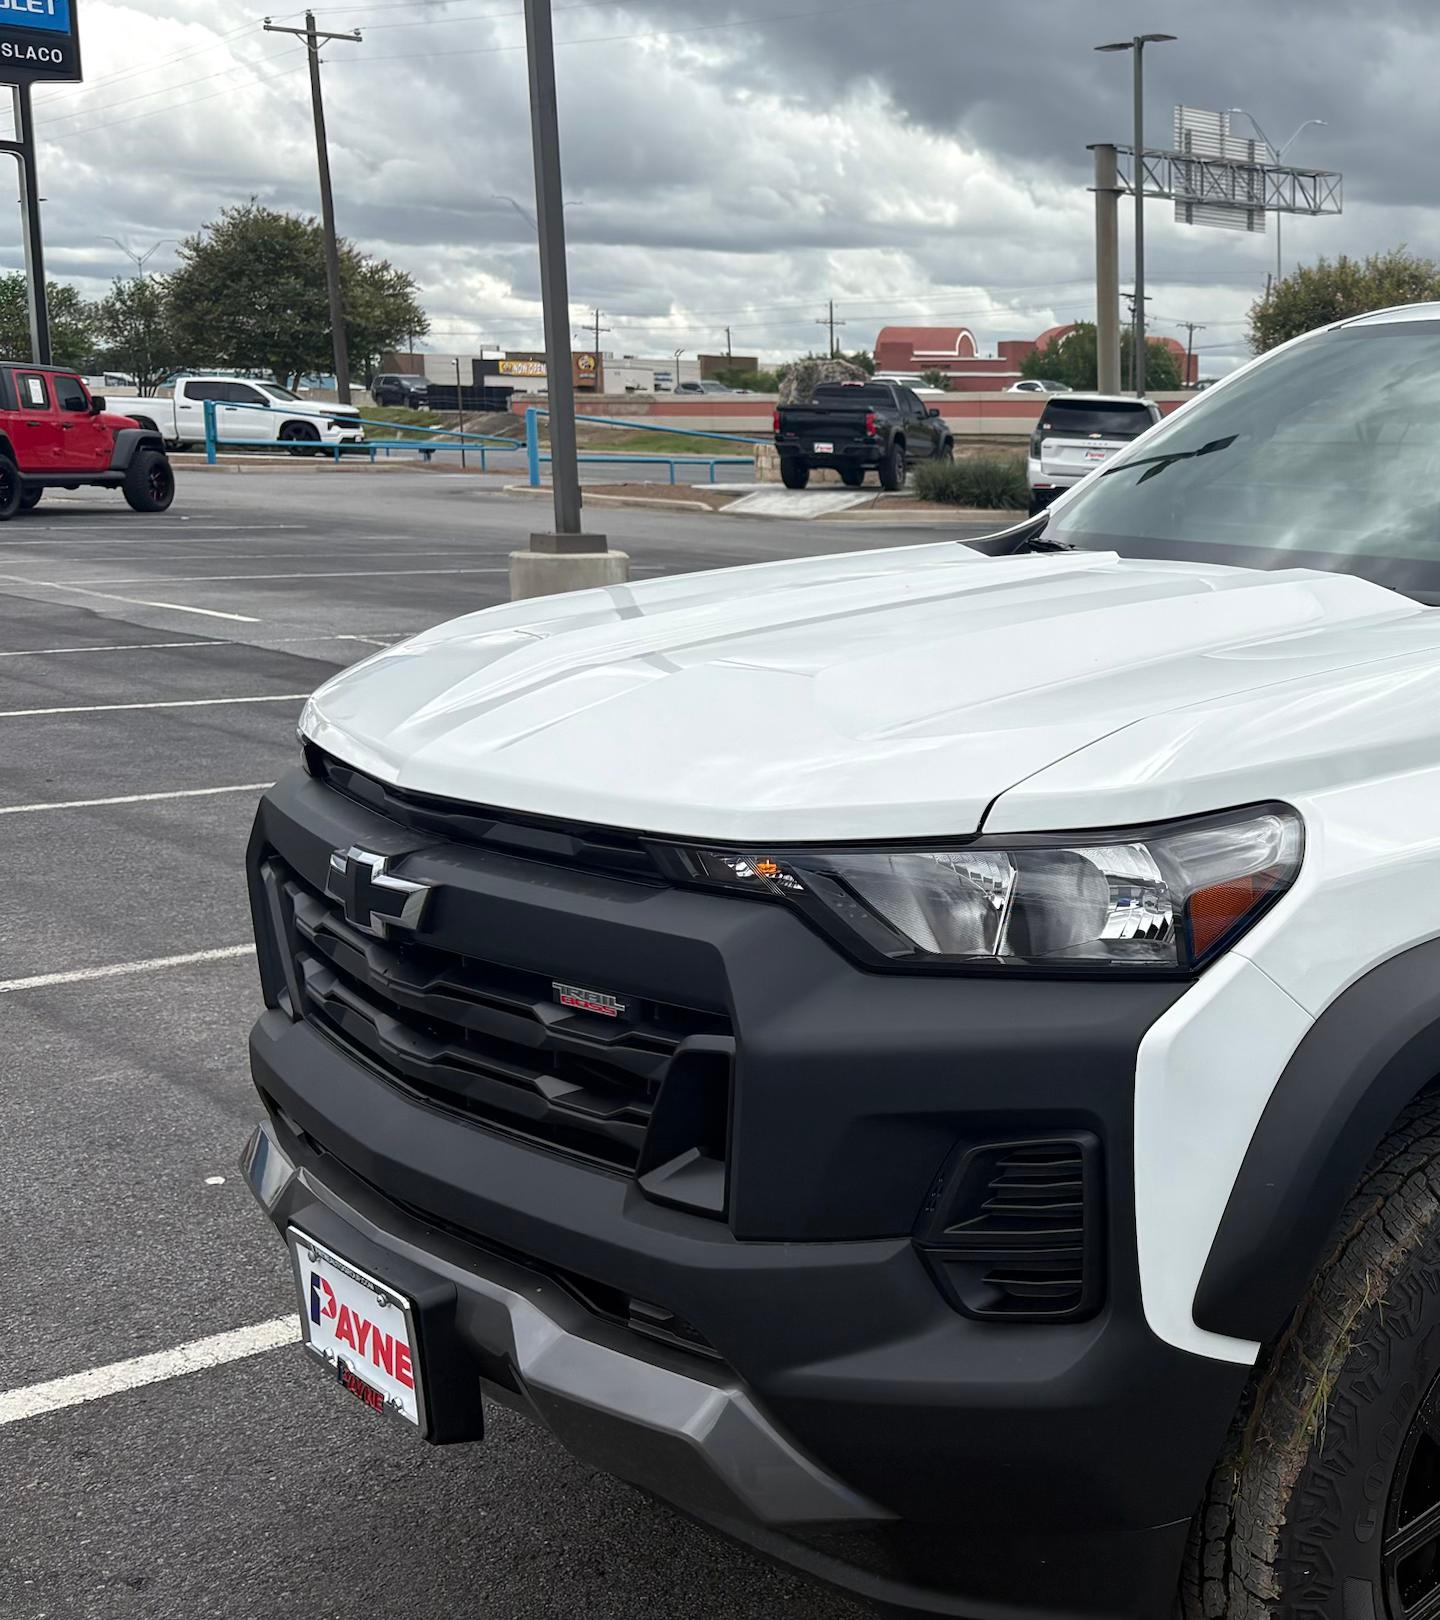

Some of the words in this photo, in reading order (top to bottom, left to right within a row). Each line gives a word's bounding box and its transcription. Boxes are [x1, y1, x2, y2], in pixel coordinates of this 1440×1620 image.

[1, 42, 63, 63] SLACO
[552, 981, 625, 1011] TRAIL
[560, 995, 617, 1017] BOSS
[311, 1271, 415, 1390] PAYNE
